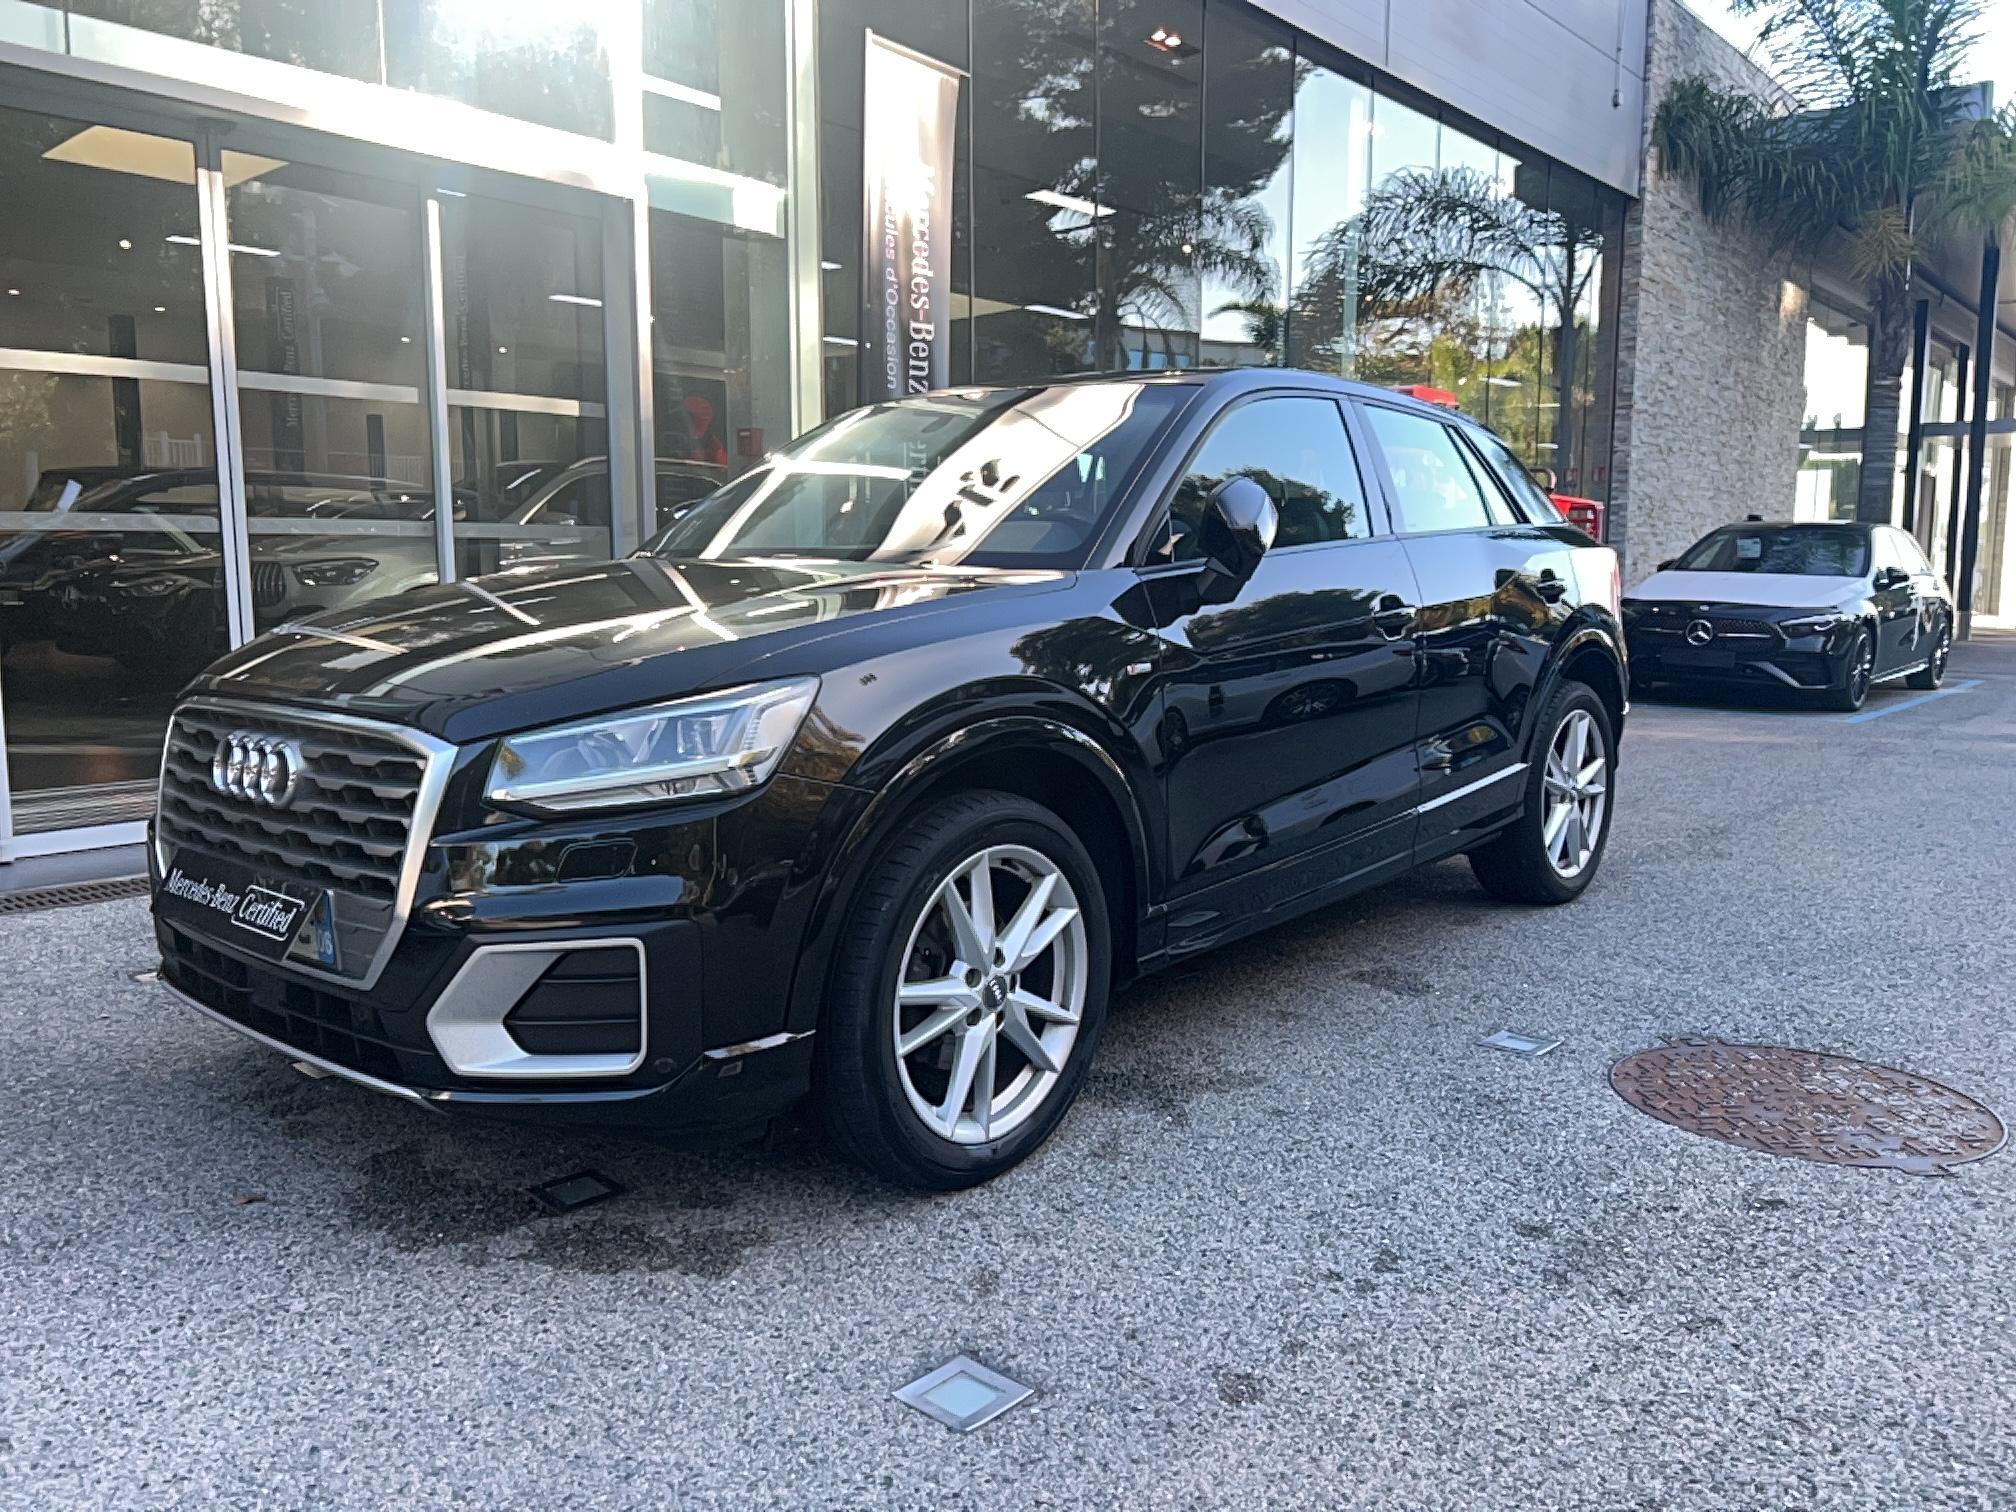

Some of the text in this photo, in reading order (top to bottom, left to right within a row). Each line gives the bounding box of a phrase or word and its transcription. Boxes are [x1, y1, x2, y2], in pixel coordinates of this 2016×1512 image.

[884, 266, 900, 390] d'Occasion
[163, 867, 298, 933] Mercedes-Benz Certified
